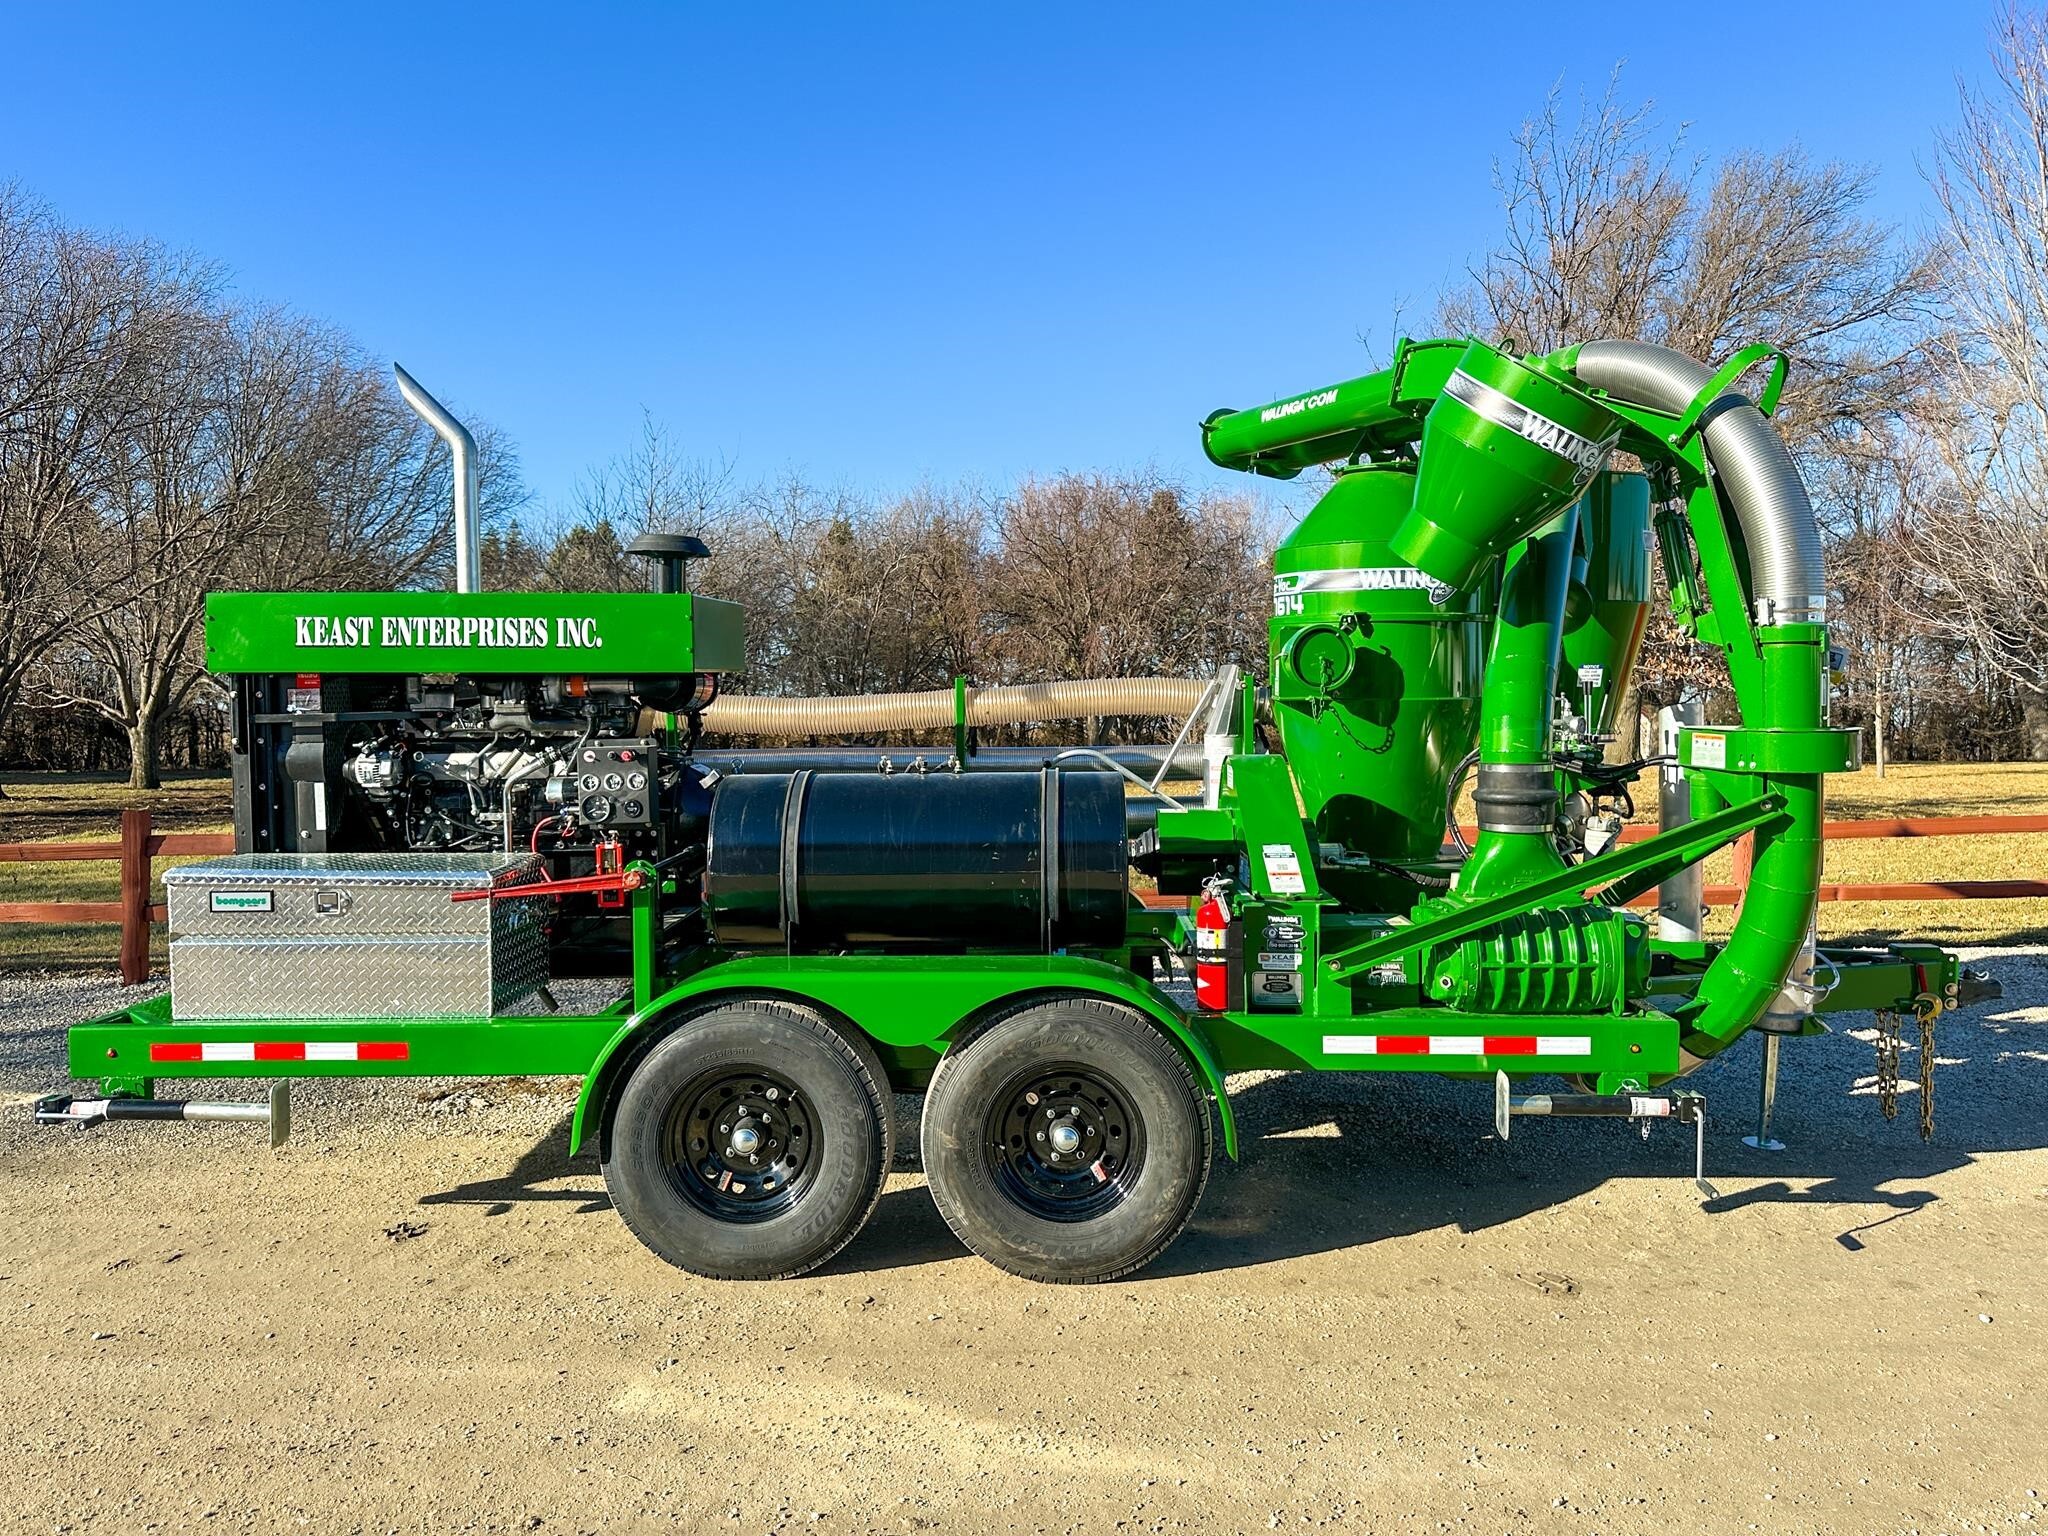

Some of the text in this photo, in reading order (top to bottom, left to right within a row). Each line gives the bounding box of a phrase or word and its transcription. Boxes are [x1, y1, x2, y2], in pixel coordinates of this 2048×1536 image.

[1358, 569, 1447, 590] WALING
[294, 616, 603, 648] KEAST ENTERPRISES INC.
